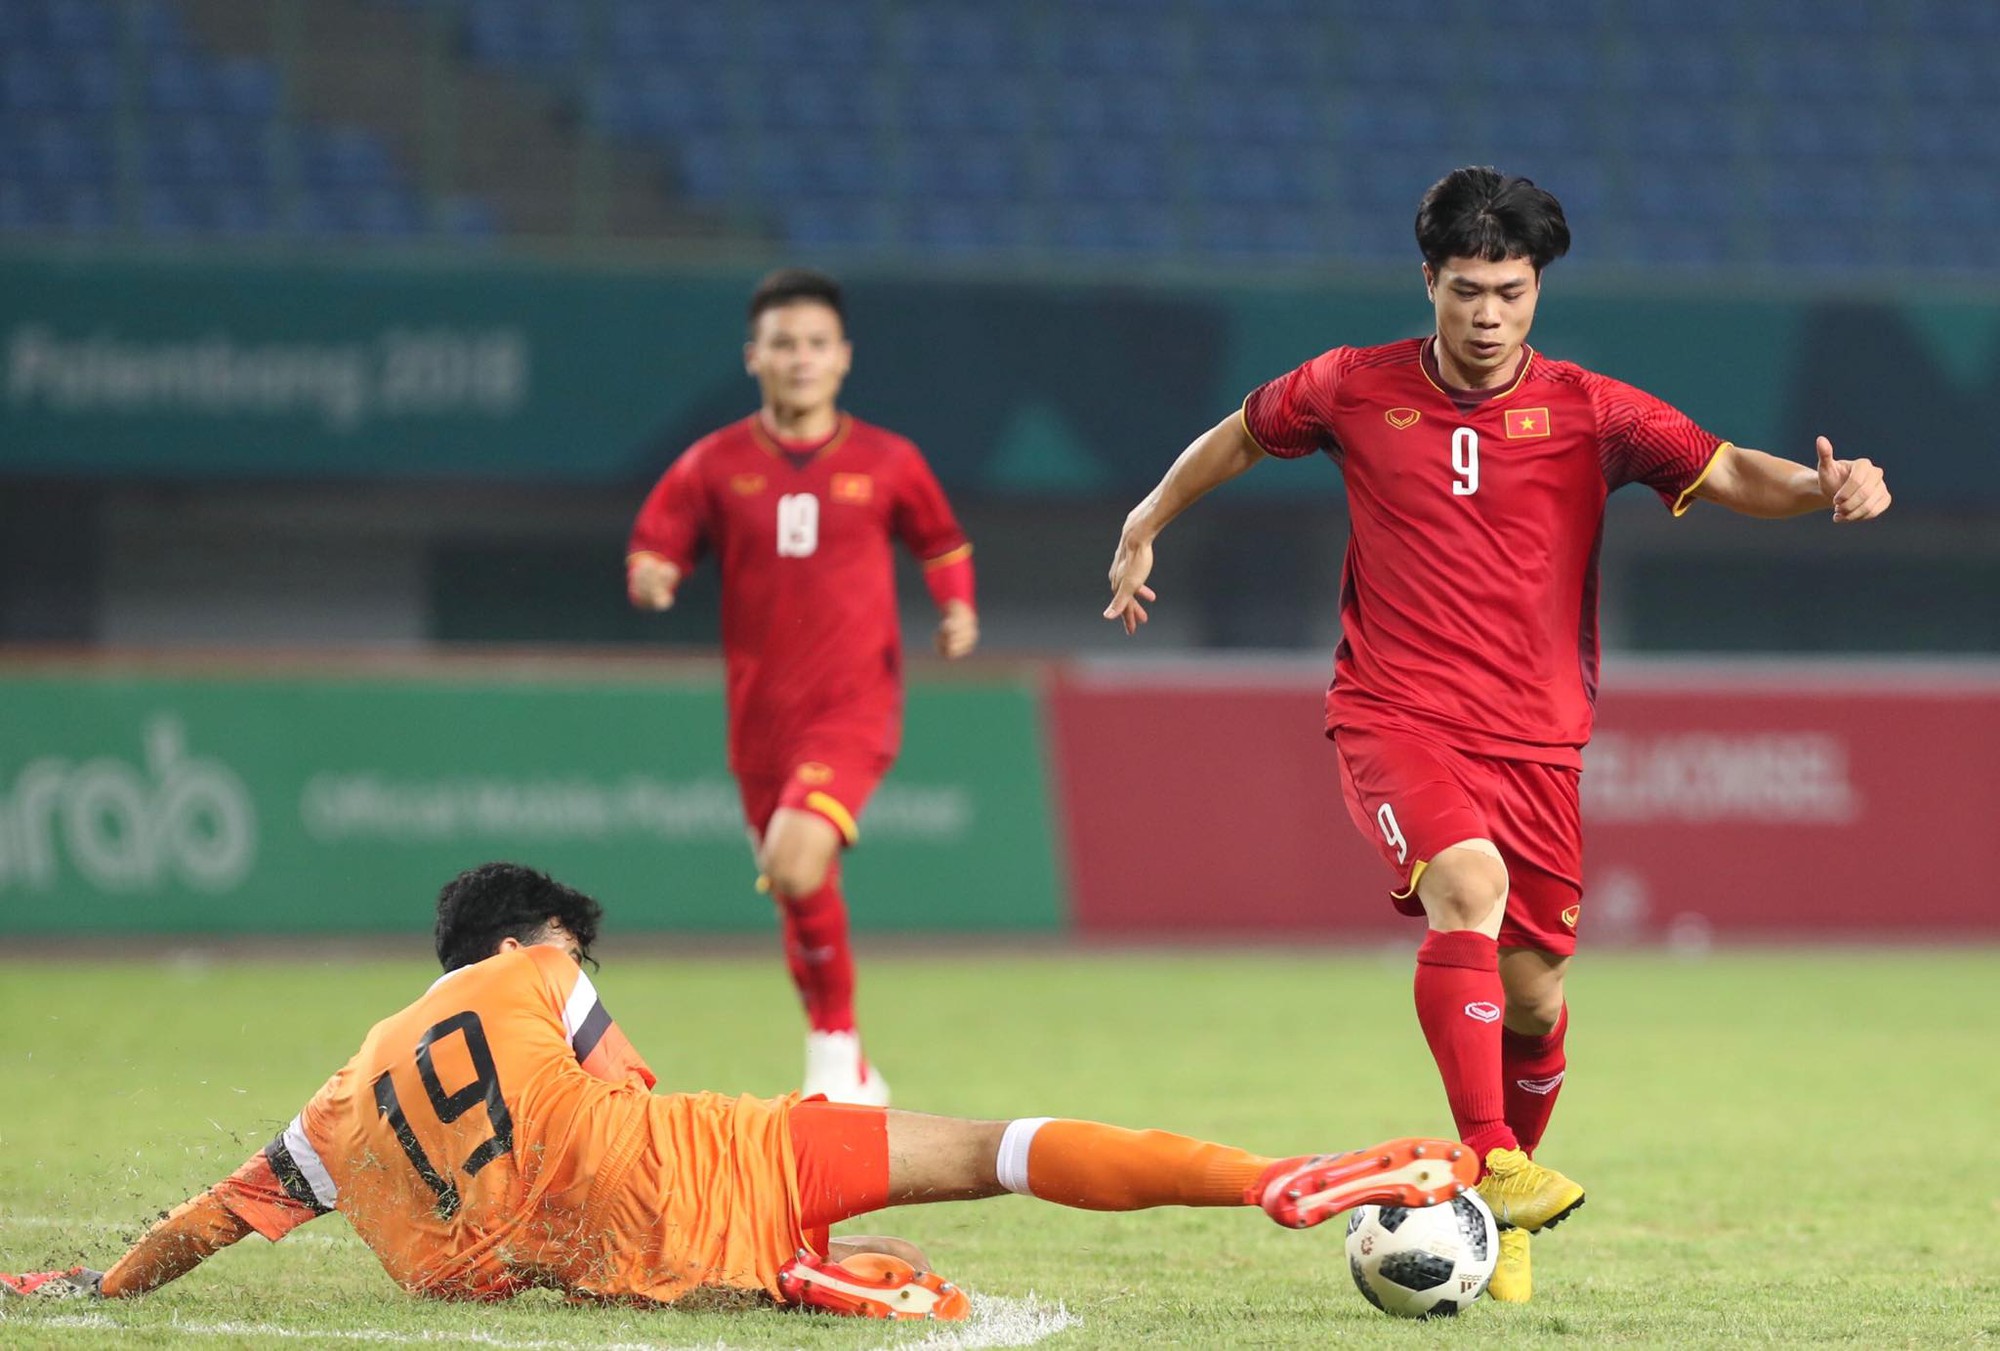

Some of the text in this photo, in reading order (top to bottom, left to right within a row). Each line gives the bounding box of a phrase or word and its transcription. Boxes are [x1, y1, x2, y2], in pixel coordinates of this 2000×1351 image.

[8, 325, 526, 430] Palembang 2018
[1451, 427, 1479, 495] 9
[777, 492, 819, 558] 19
[0, 714, 254, 889] rab
[1377, 803, 1407, 864] 9
[373, 1010, 514, 1221] 19
